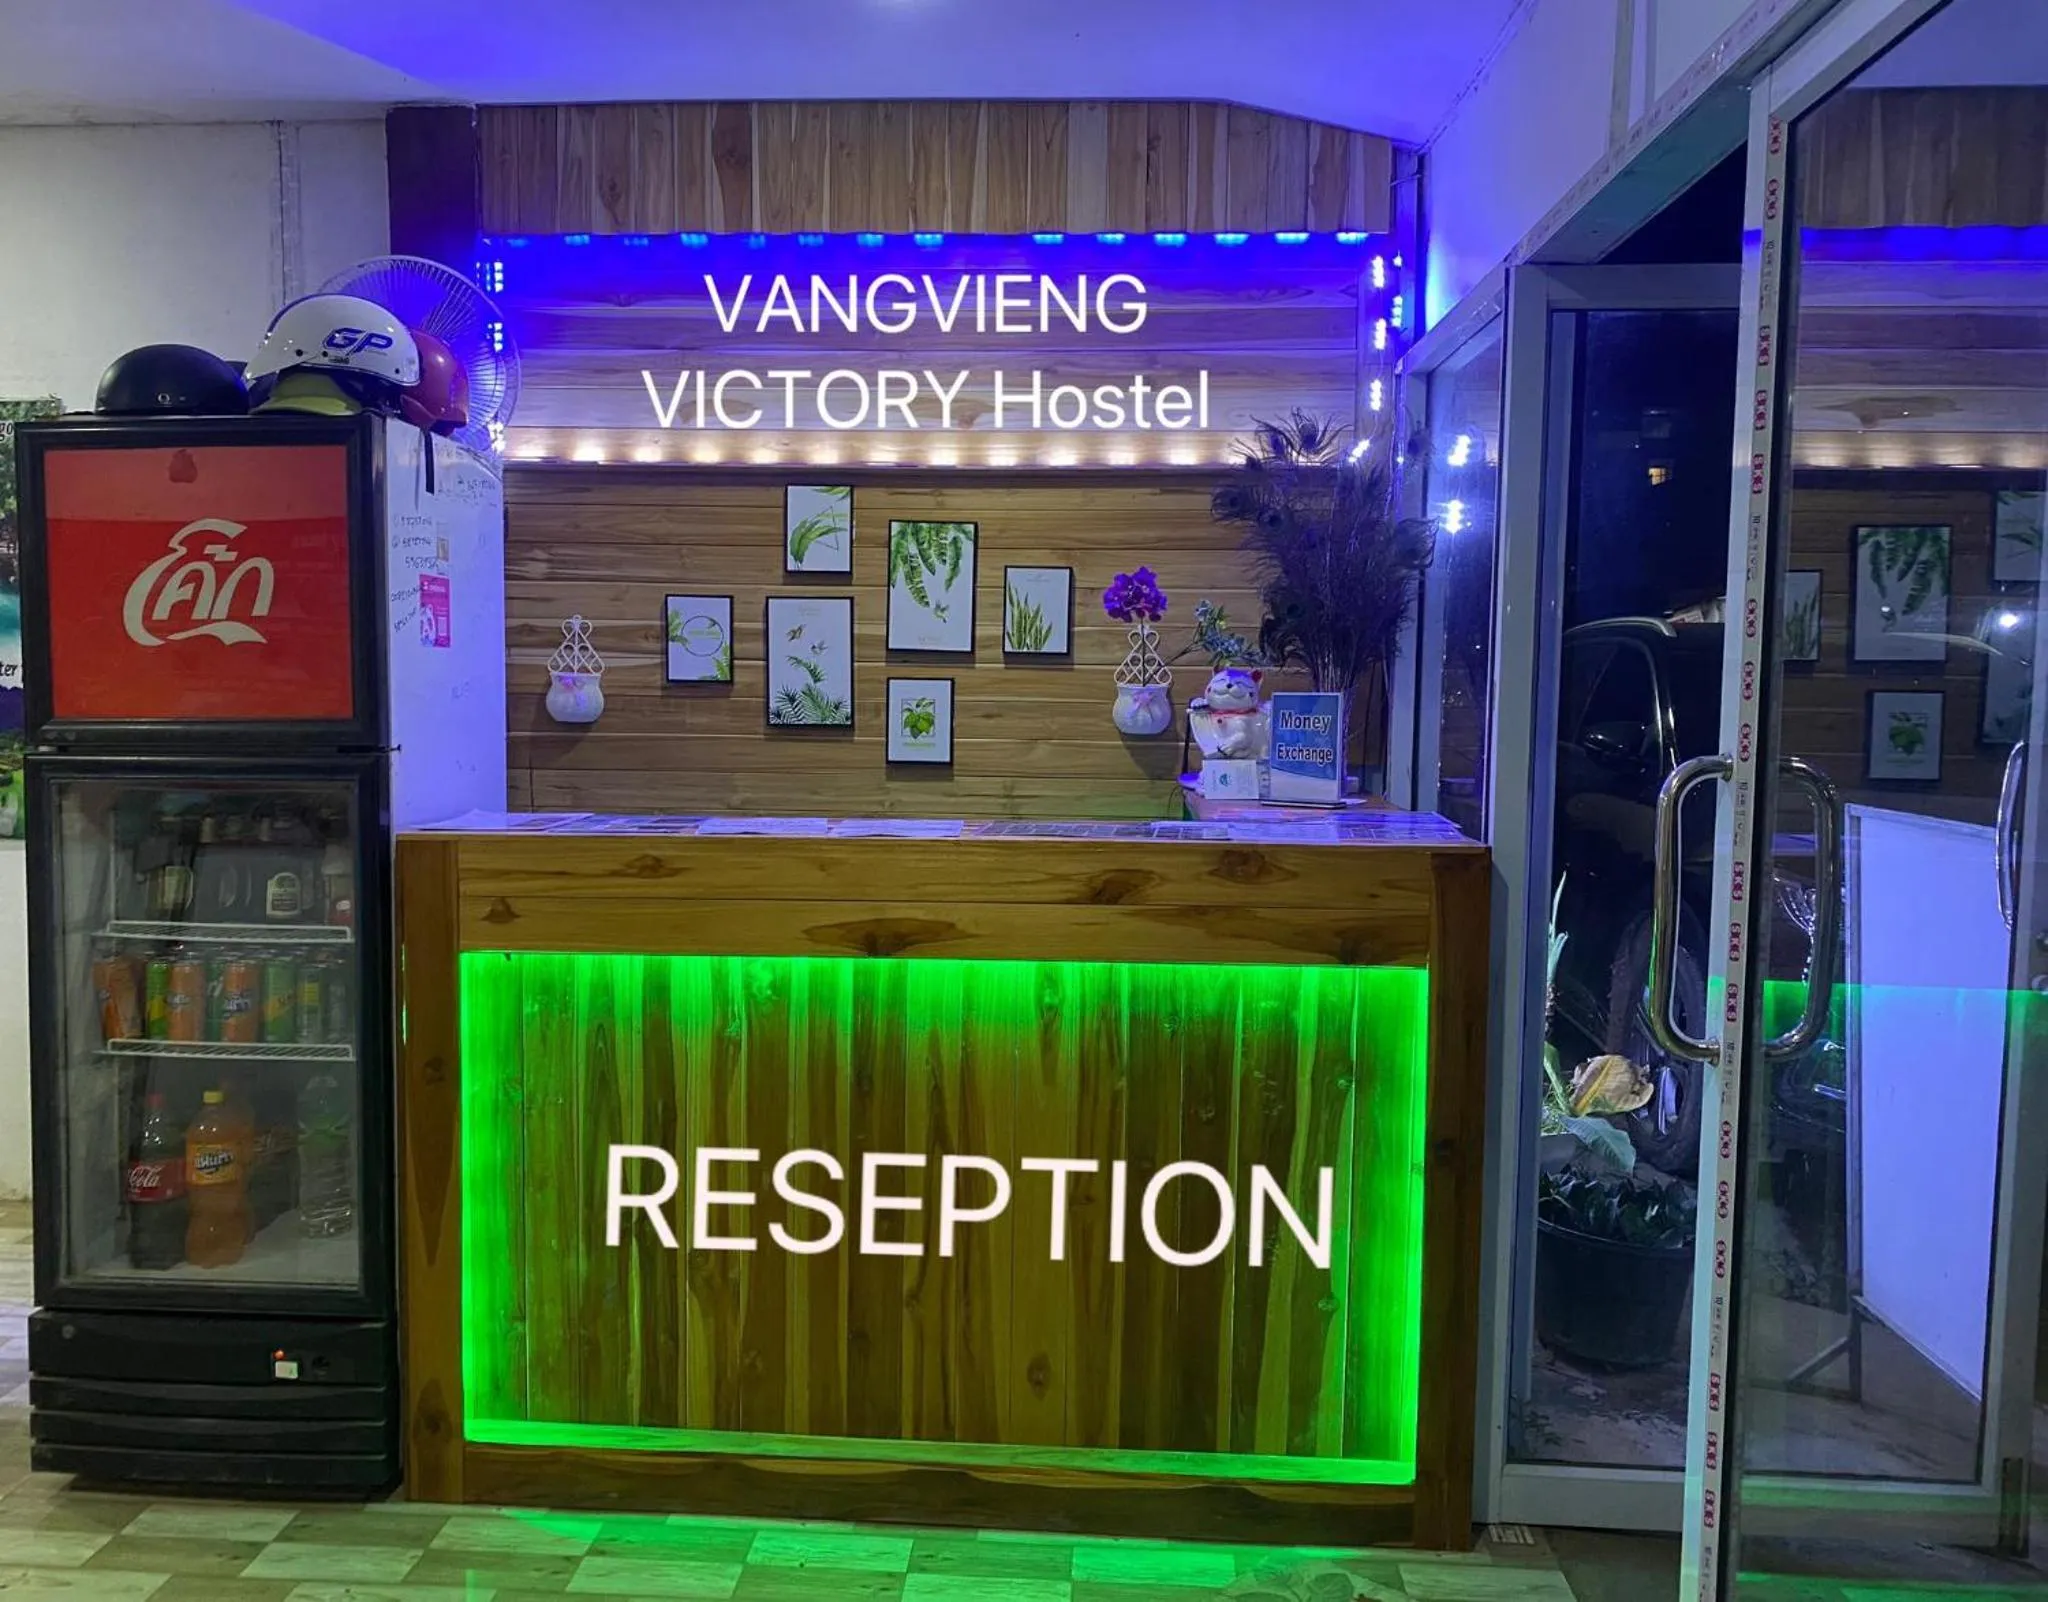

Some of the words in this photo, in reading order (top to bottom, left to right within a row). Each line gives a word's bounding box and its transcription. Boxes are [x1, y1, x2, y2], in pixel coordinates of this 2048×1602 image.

[323, 328, 393, 353] GP
[1279, 709, 1332, 735] Money
[1277, 742, 1333, 766] Exchange
[1732, 861, 1744, 900] SKS
[1728, 922, 1741, 961] SKS
[1726, 983, 1738, 1022] SKS
